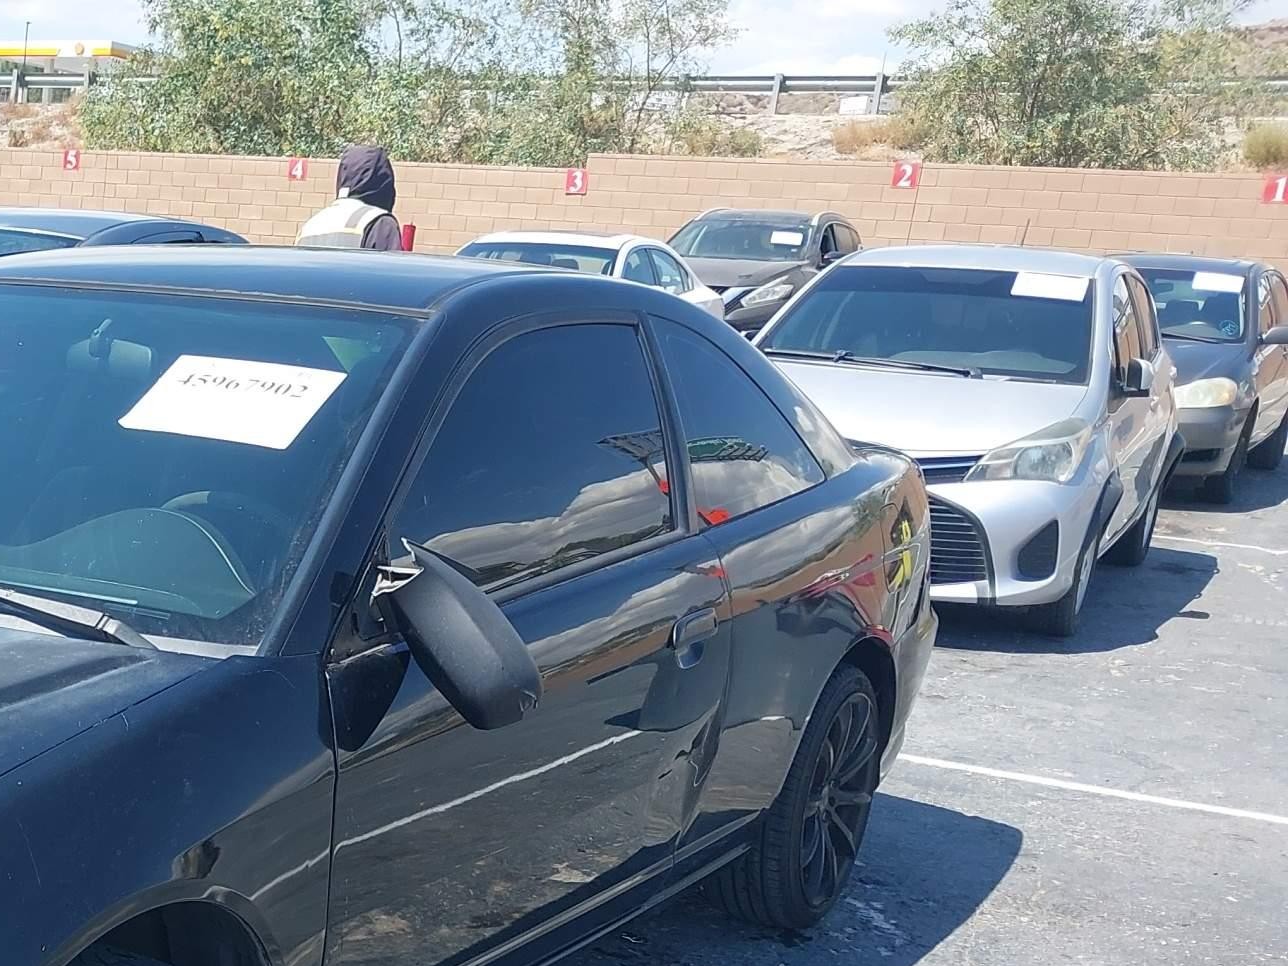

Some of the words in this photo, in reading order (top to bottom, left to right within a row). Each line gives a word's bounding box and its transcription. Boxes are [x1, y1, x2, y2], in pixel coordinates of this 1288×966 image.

[66, 150, 76, 169] 5
[291, 160, 303, 179] 4
[569, 171, 583, 192] 3
[896, 164, 912, 187] 2
[1272, 176, 1287, 201] 1
[176, 373, 309, 398] 45967902
